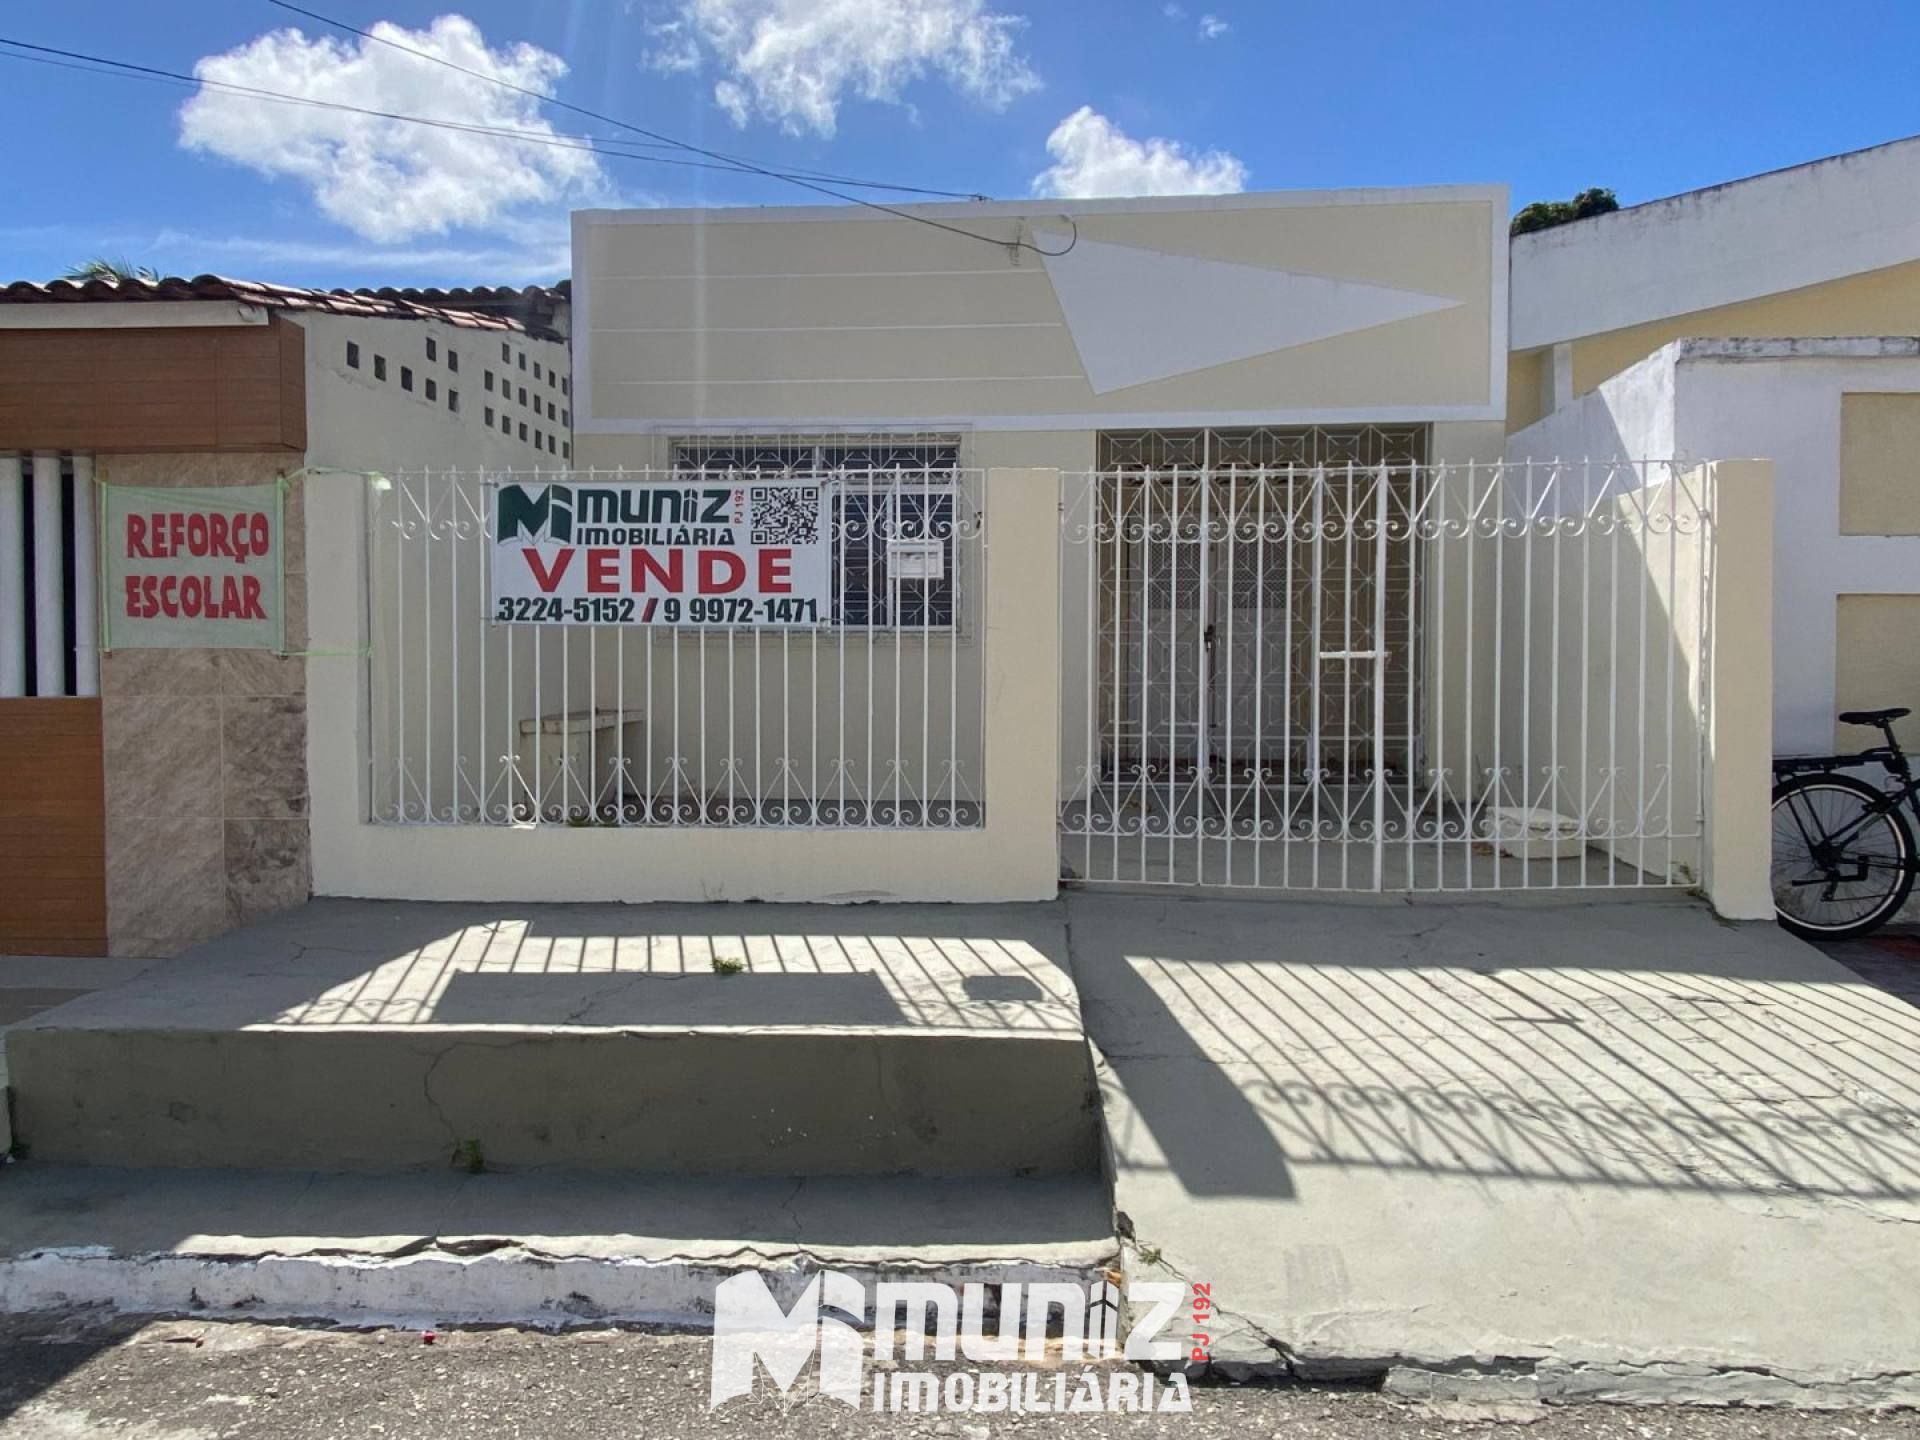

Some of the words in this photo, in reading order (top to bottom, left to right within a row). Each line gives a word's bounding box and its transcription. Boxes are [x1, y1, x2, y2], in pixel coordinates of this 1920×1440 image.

[735, 489, 744, 507] 192
[735, 511, 743, 524] PJ
[127, 512, 269, 564] REFORÇO
[576, 525, 735, 545] IMOBILIÁRIA
[521, 548, 792, 593] VENDE
[125, 575, 268, 620] ESCOLAR
[499, 597, 634, 623] 3224-5152
[664, 597, 681, 622] 9
[690, 597, 818, 623] 9972-1471
